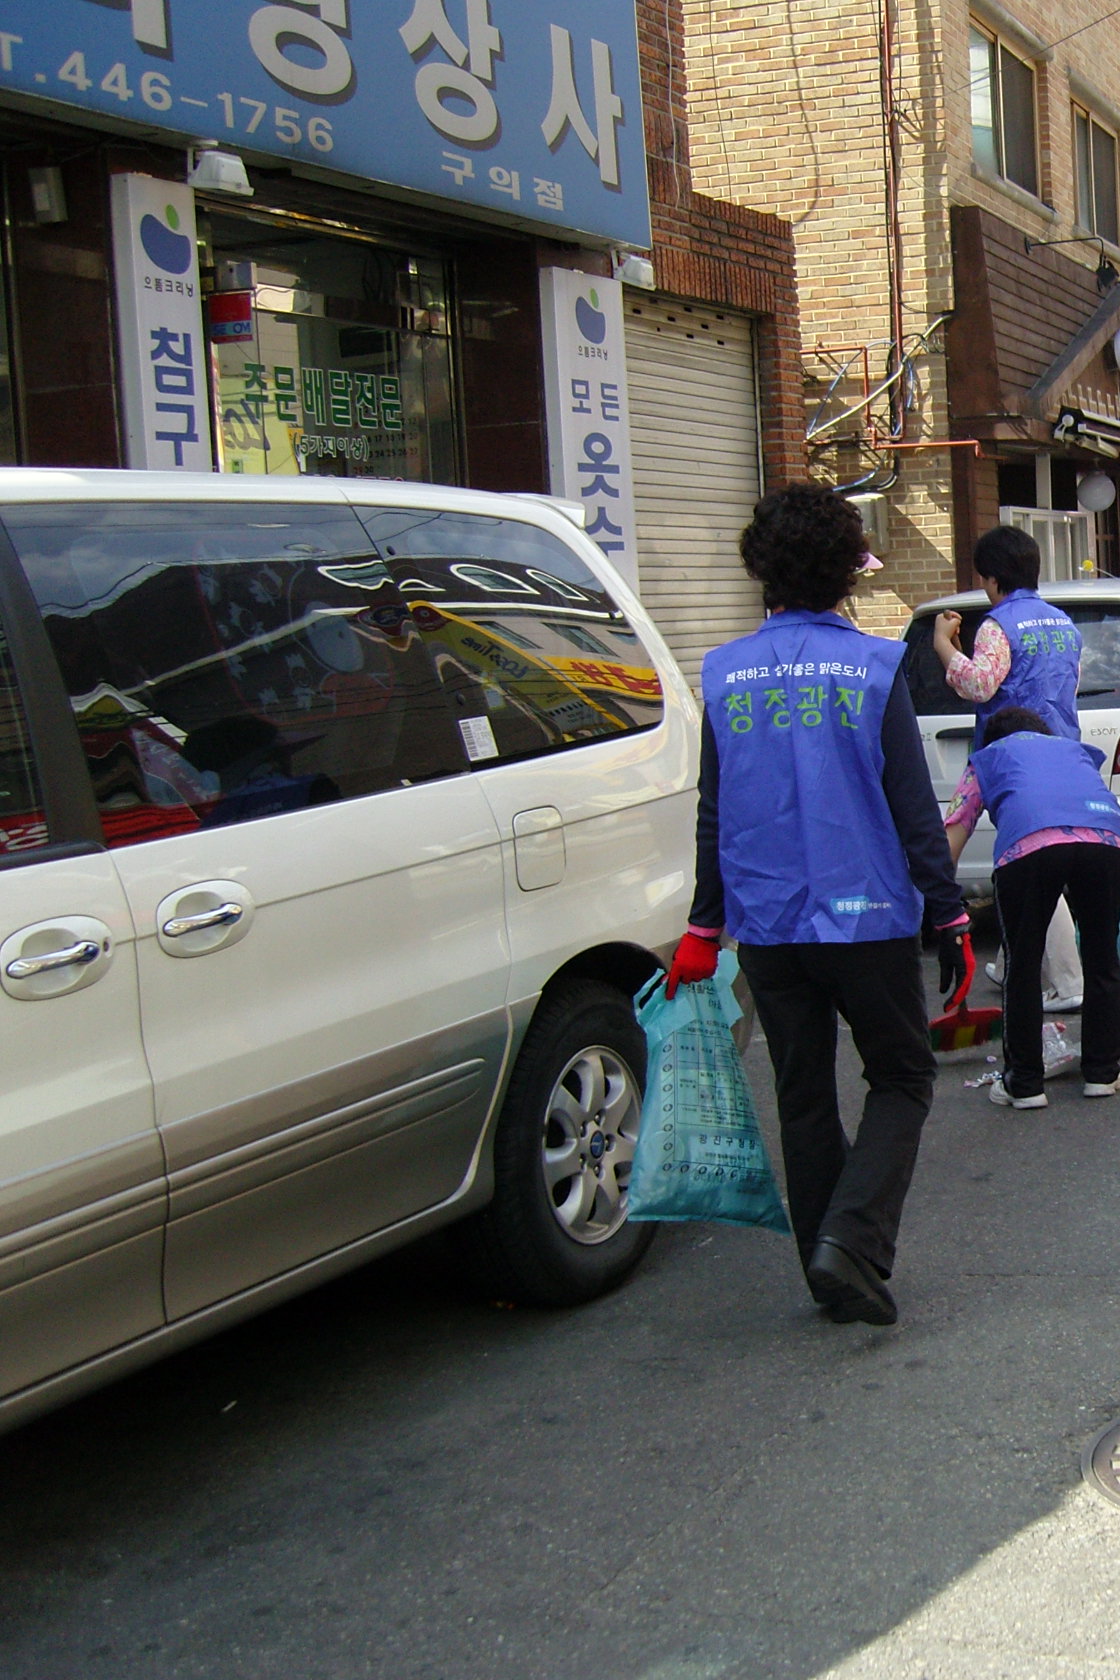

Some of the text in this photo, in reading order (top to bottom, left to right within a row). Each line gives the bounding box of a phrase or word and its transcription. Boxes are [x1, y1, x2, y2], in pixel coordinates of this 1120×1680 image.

[441, 151, 564, 212] 구의점
[143, 276, 194, 298] 으뜸크리닝
[150, 326, 200, 467] 침구
[244, 363, 402, 431] 주문배달전문
[571, 378, 620, 422] 모든
[293, 434, 370, 463] (5가지이상)
[725, 684, 865, 734] 청정광진
